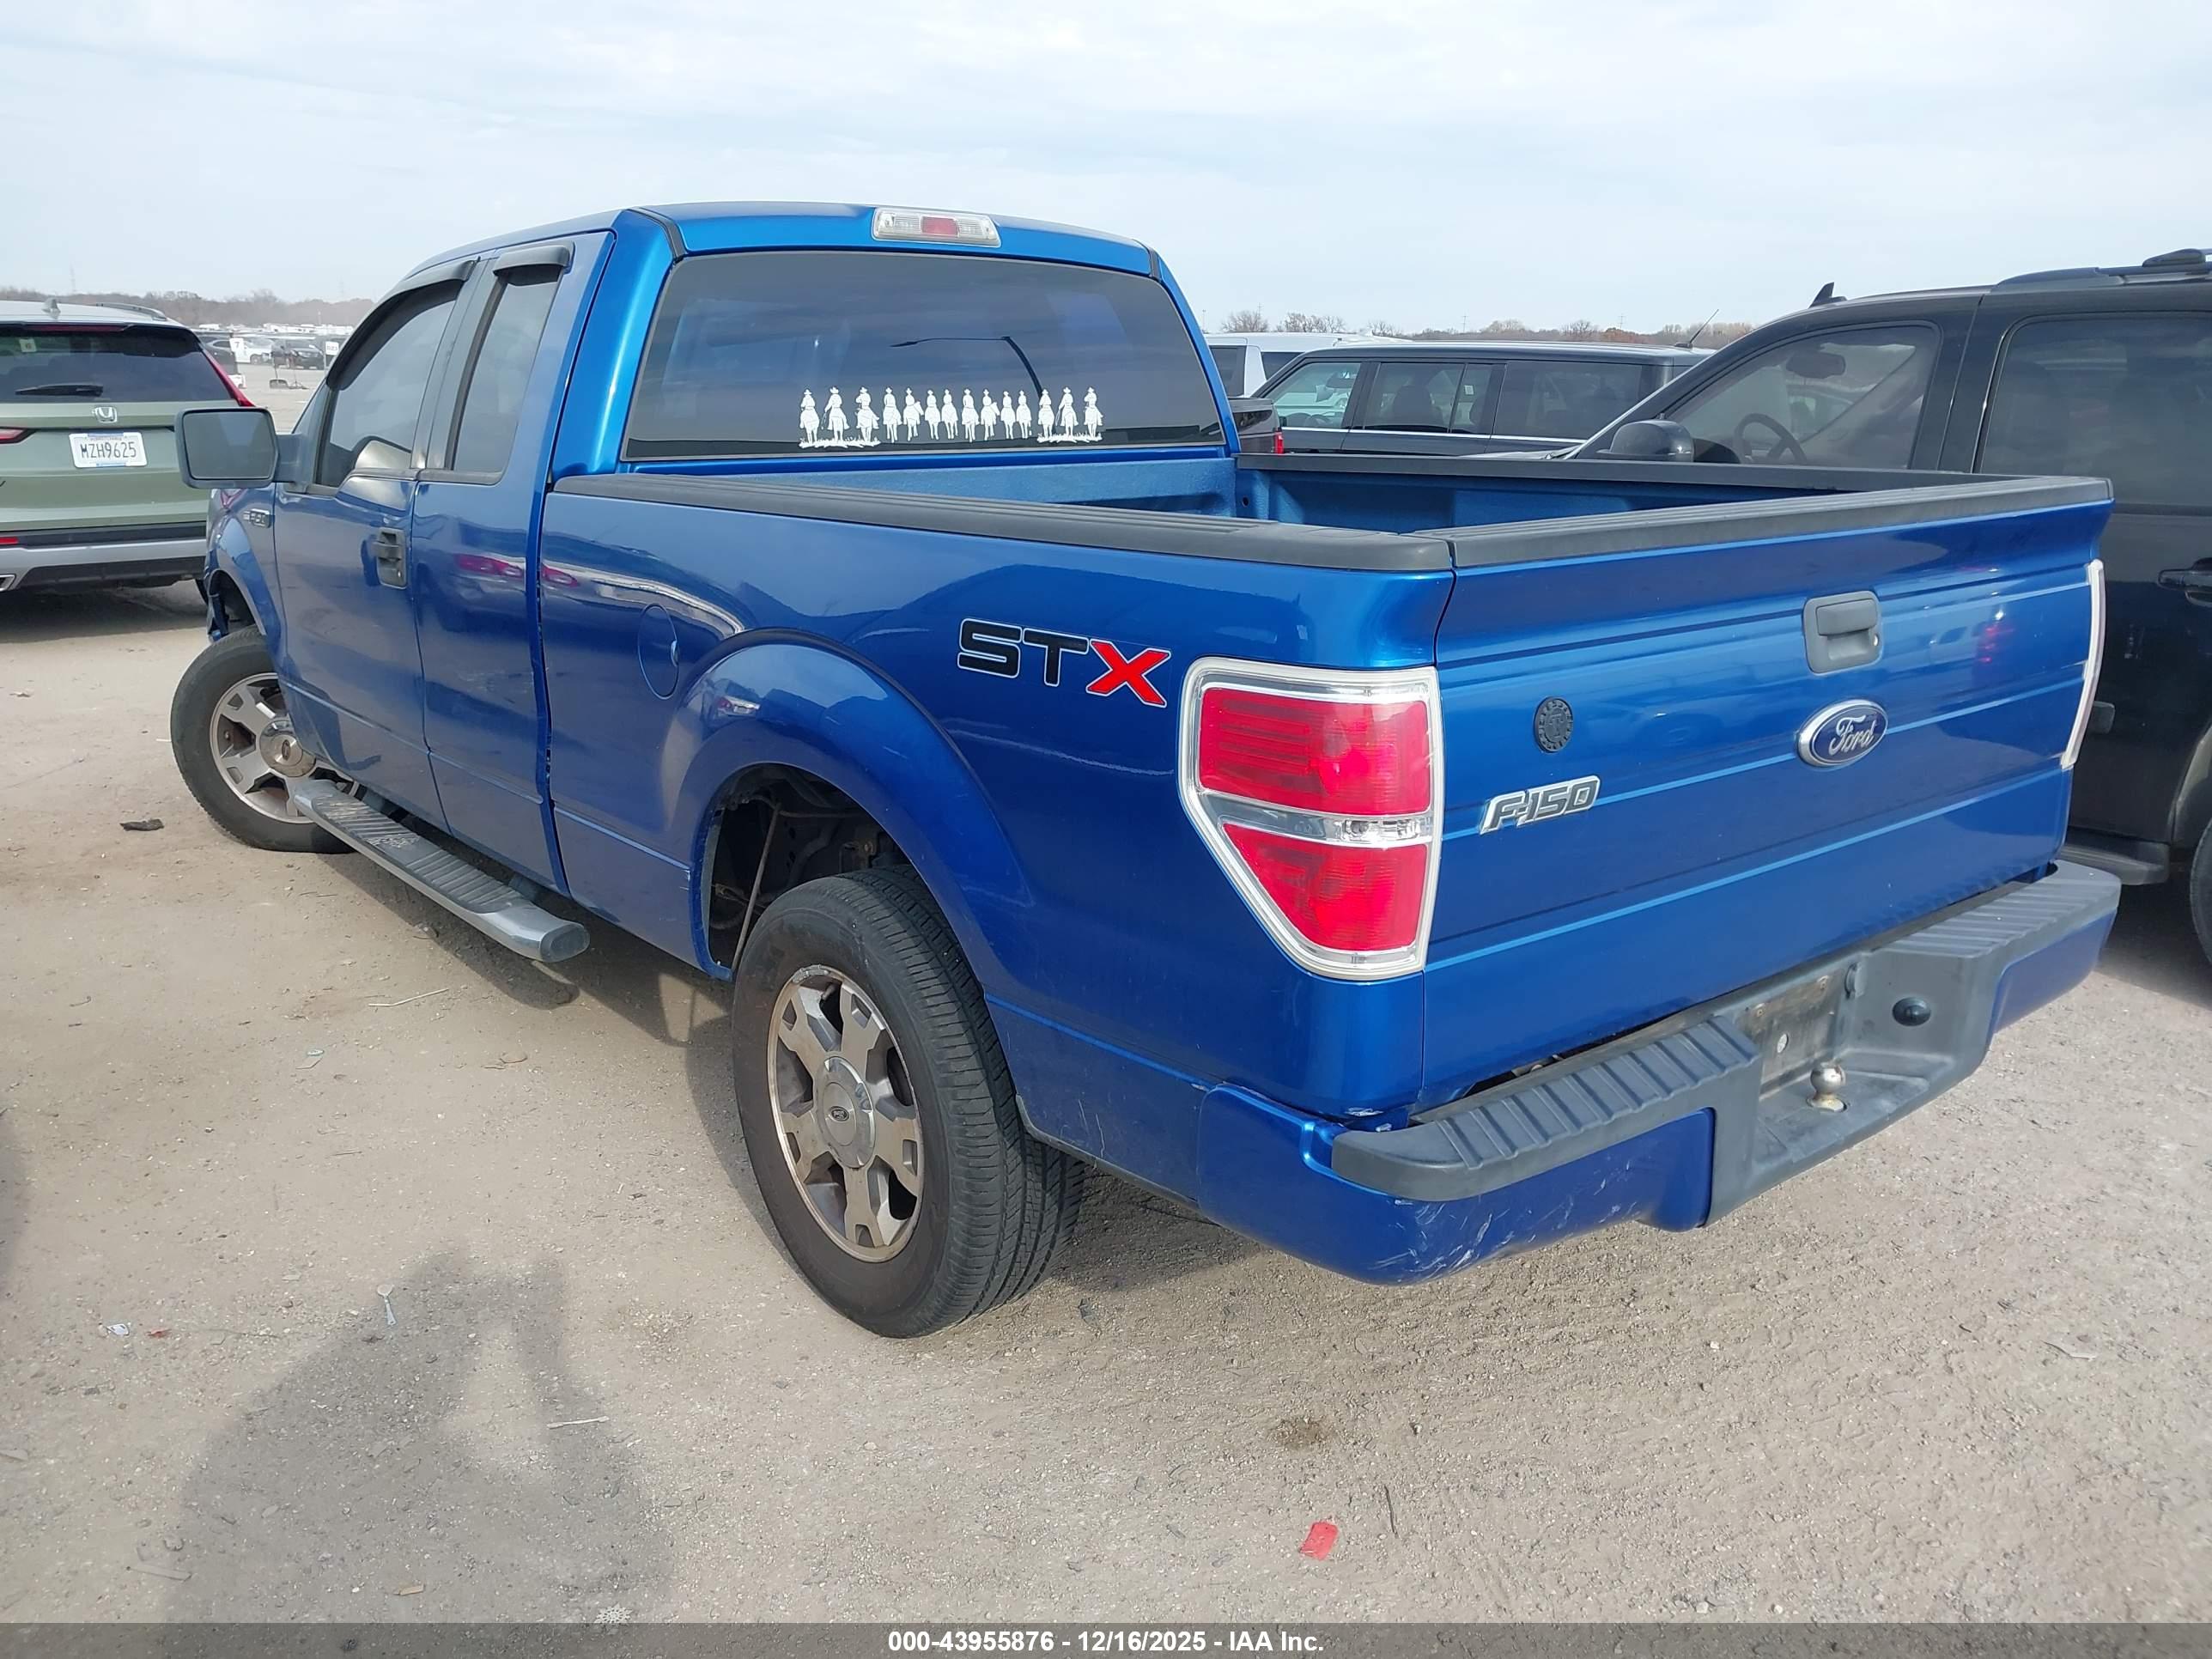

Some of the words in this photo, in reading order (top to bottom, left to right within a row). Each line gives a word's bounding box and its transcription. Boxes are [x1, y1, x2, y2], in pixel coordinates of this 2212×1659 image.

[80, 441, 137, 459] MZH9625
[957, 618, 1171, 708] STX
[1828, 714, 1877, 756] Ford
[1480, 775, 1600, 835] F-150
